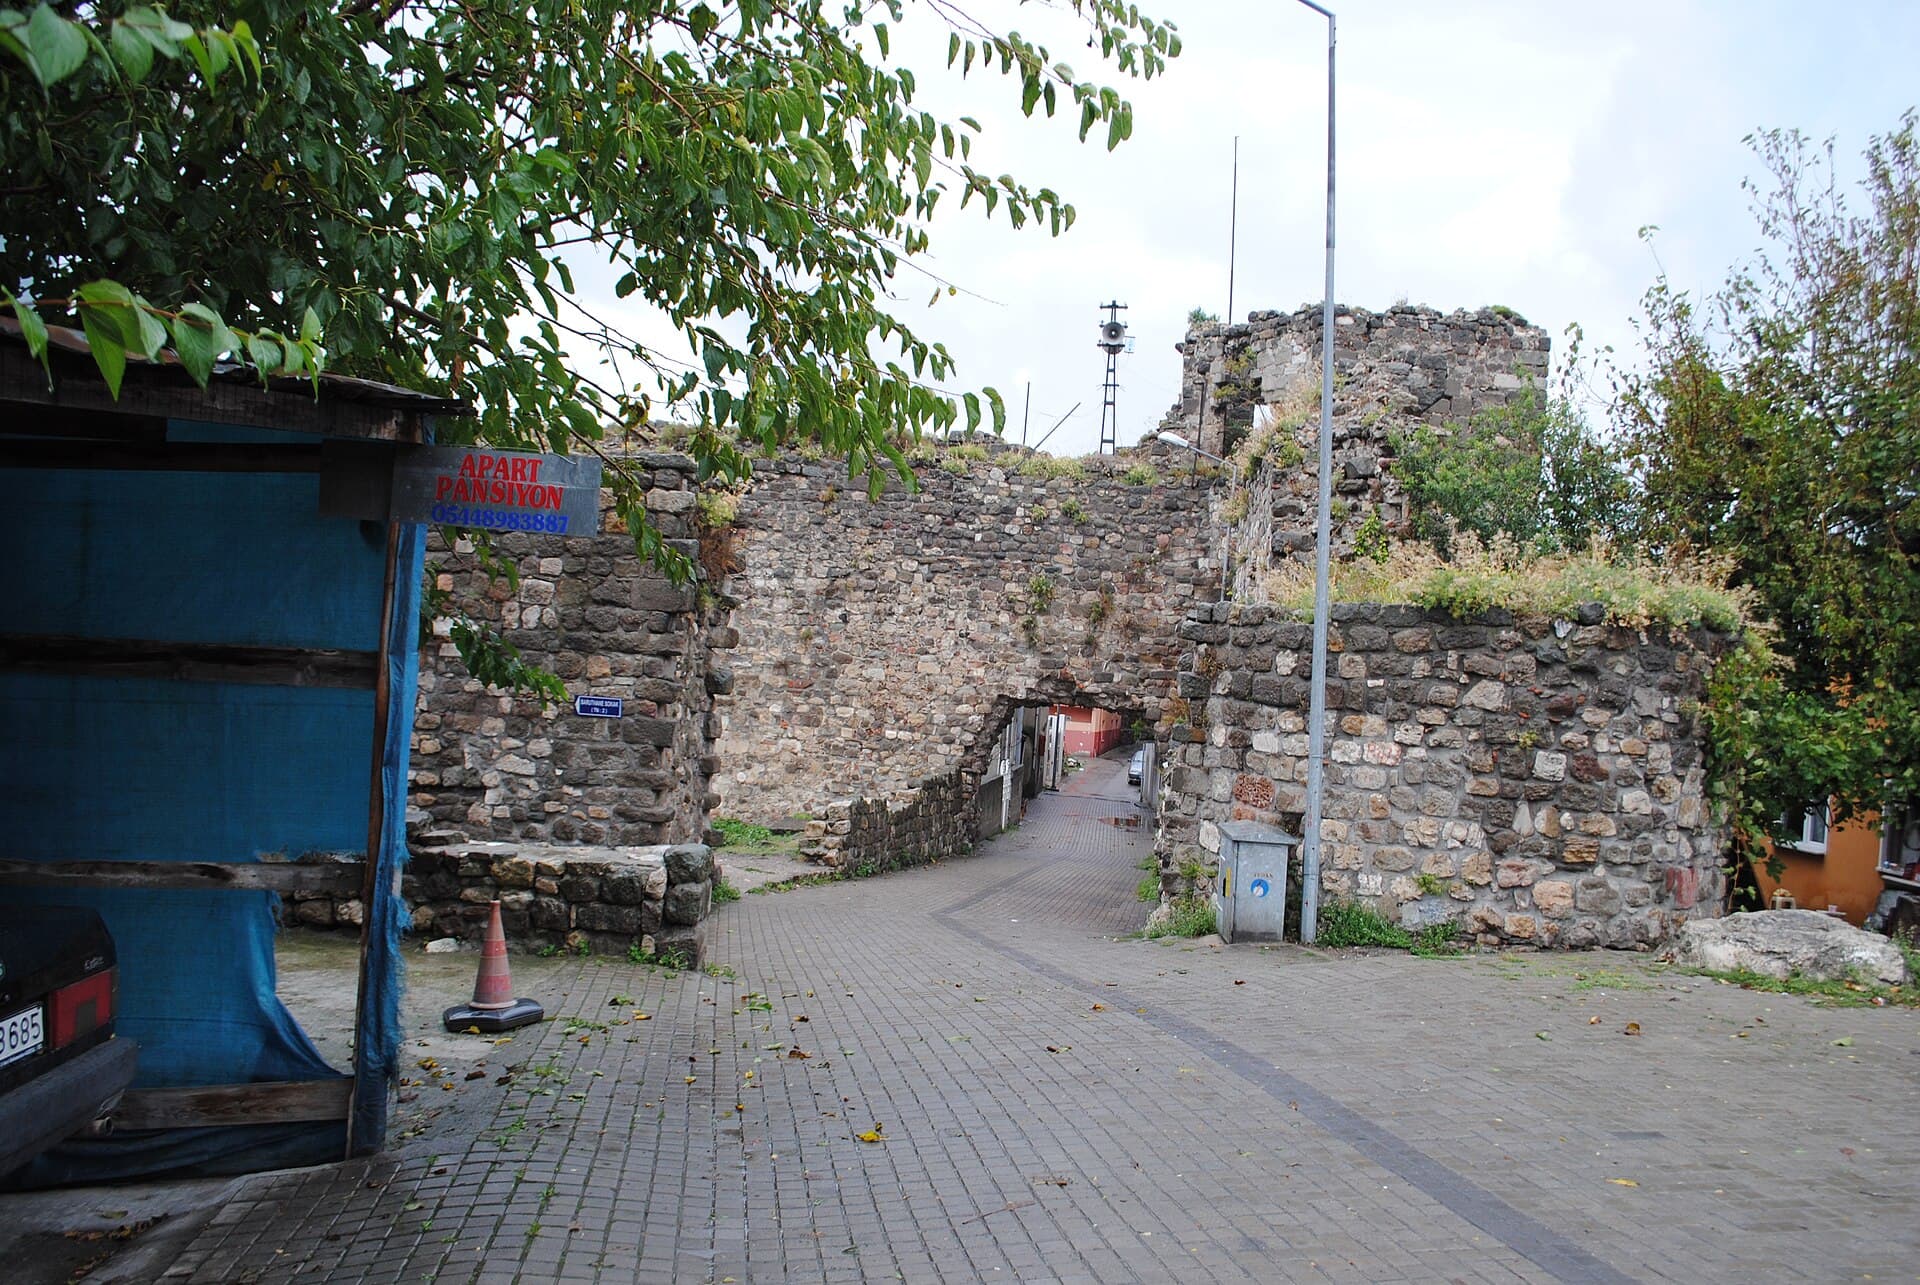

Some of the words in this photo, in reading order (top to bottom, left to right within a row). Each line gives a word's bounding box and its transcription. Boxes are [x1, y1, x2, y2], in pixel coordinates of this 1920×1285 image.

[459, 454, 542, 483] APART
[436, 476, 564, 511] PANSIYON
[432, 505, 569, 533] 05448983887
